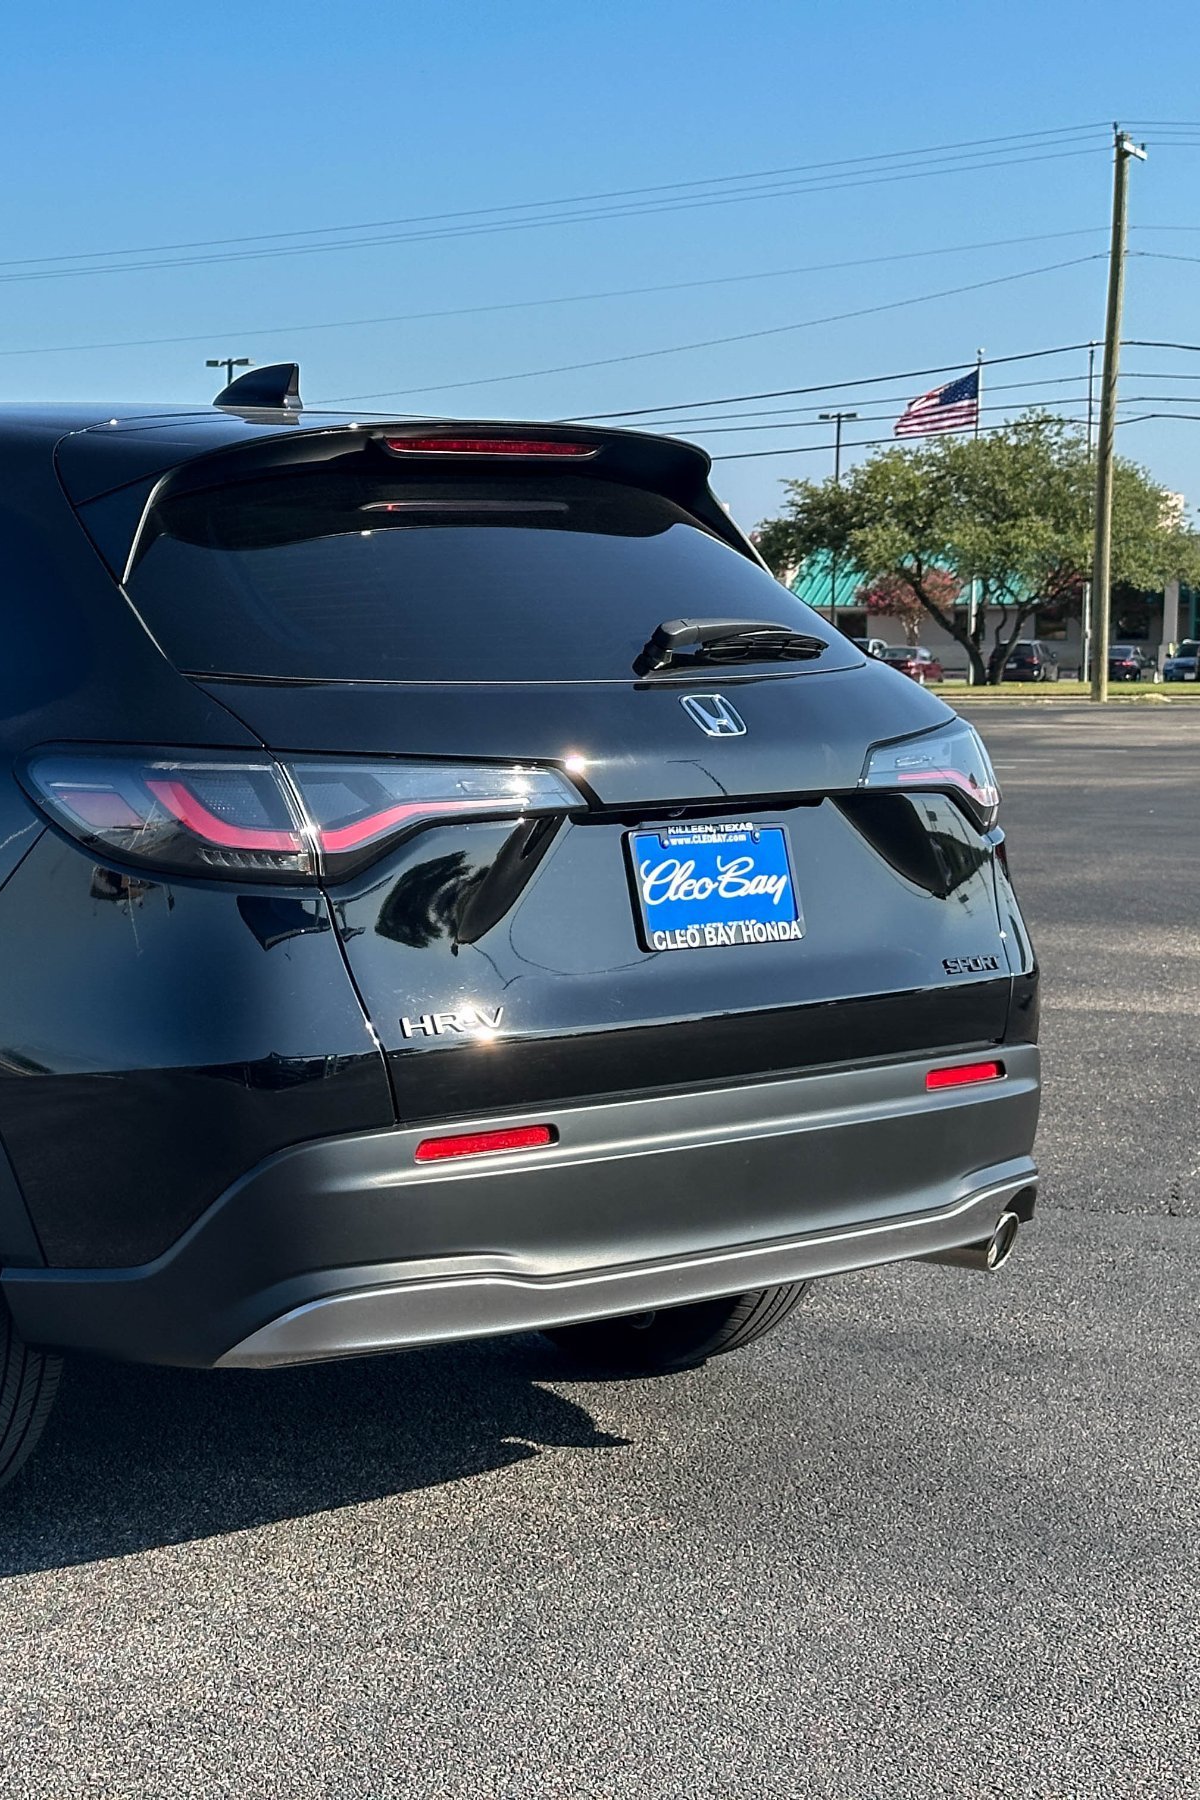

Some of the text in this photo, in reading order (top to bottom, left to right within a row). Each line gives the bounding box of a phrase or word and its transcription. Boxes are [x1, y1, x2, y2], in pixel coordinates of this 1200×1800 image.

[668, 822, 754, 835] KILLEEN, TEXAS
[640, 855, 788, 906] Cleo Bay
[653, 929, 700, 950] CLEO
[704, 925, 738, 947] BAY
[741, 920, 803, 943] HONDA
[942, 955, 999, 975] SPORT
[399, 1006, 504, 1038] HR-V
